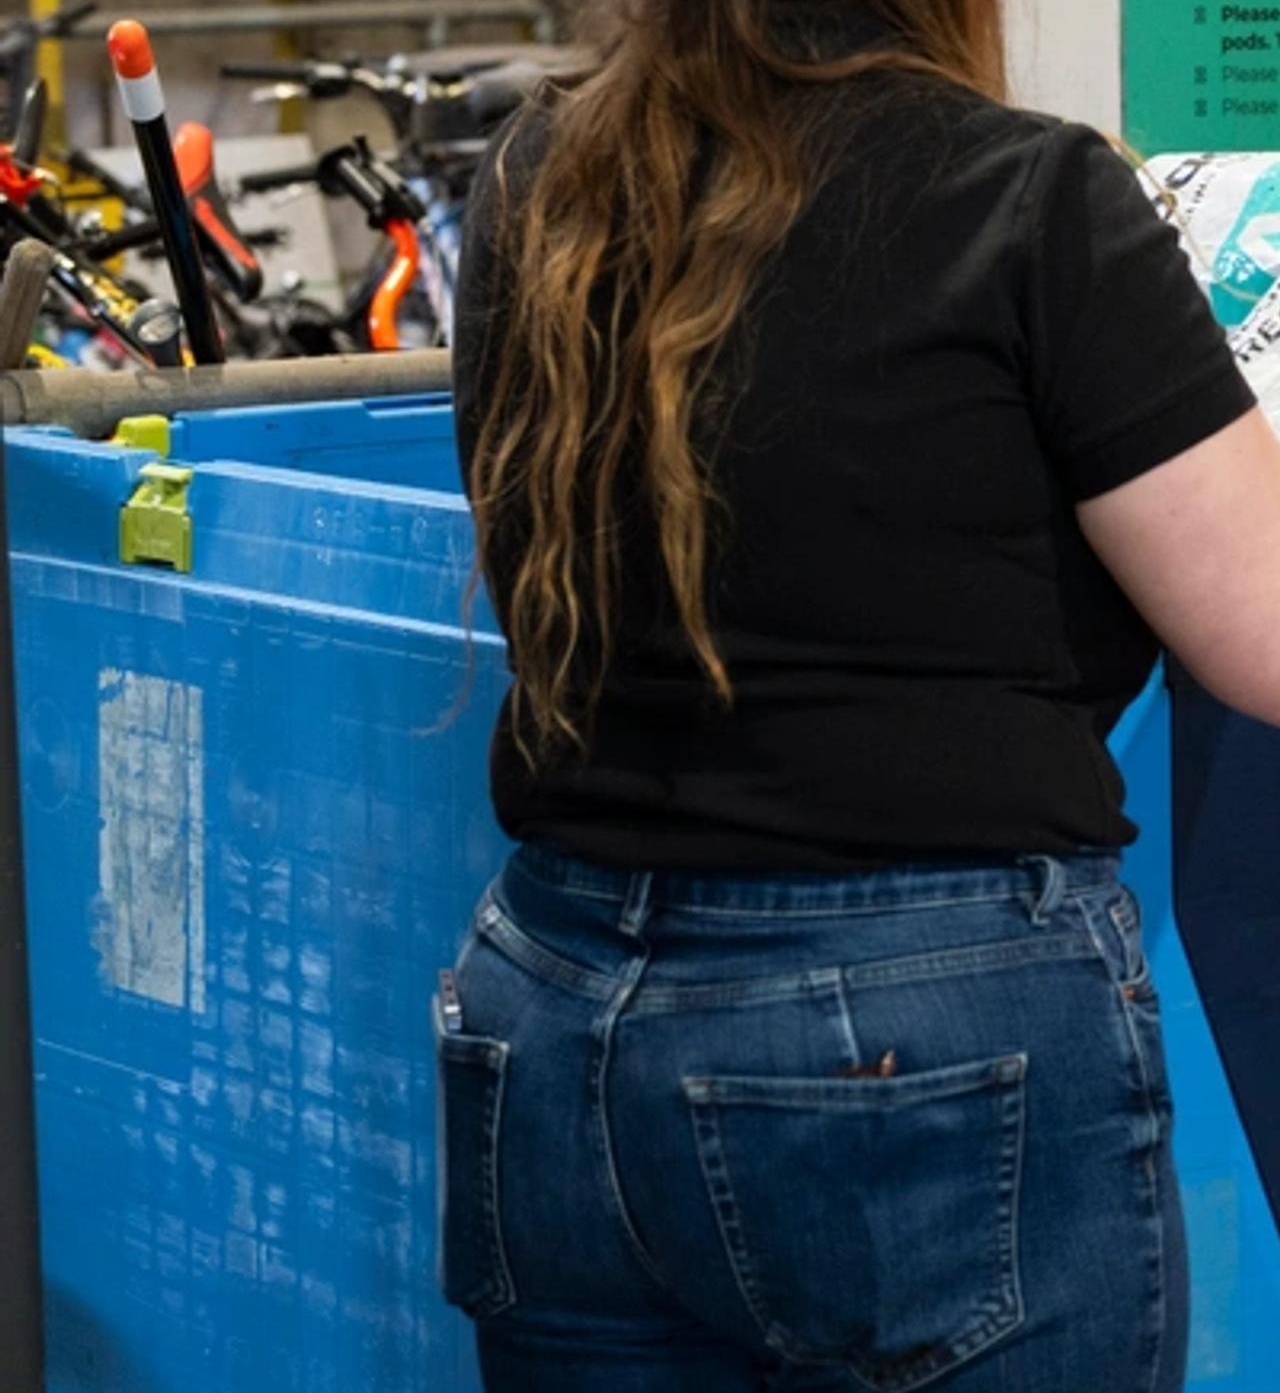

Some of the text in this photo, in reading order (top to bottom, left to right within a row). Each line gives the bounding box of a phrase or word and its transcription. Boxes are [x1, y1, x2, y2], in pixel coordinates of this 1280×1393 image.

[1221, 4, 1280, 23] Please
[1221, 32, 1271, 54] pods.
[1221, 65, 1279, 83] Please
[1221, 97, 1279, 115] Please
